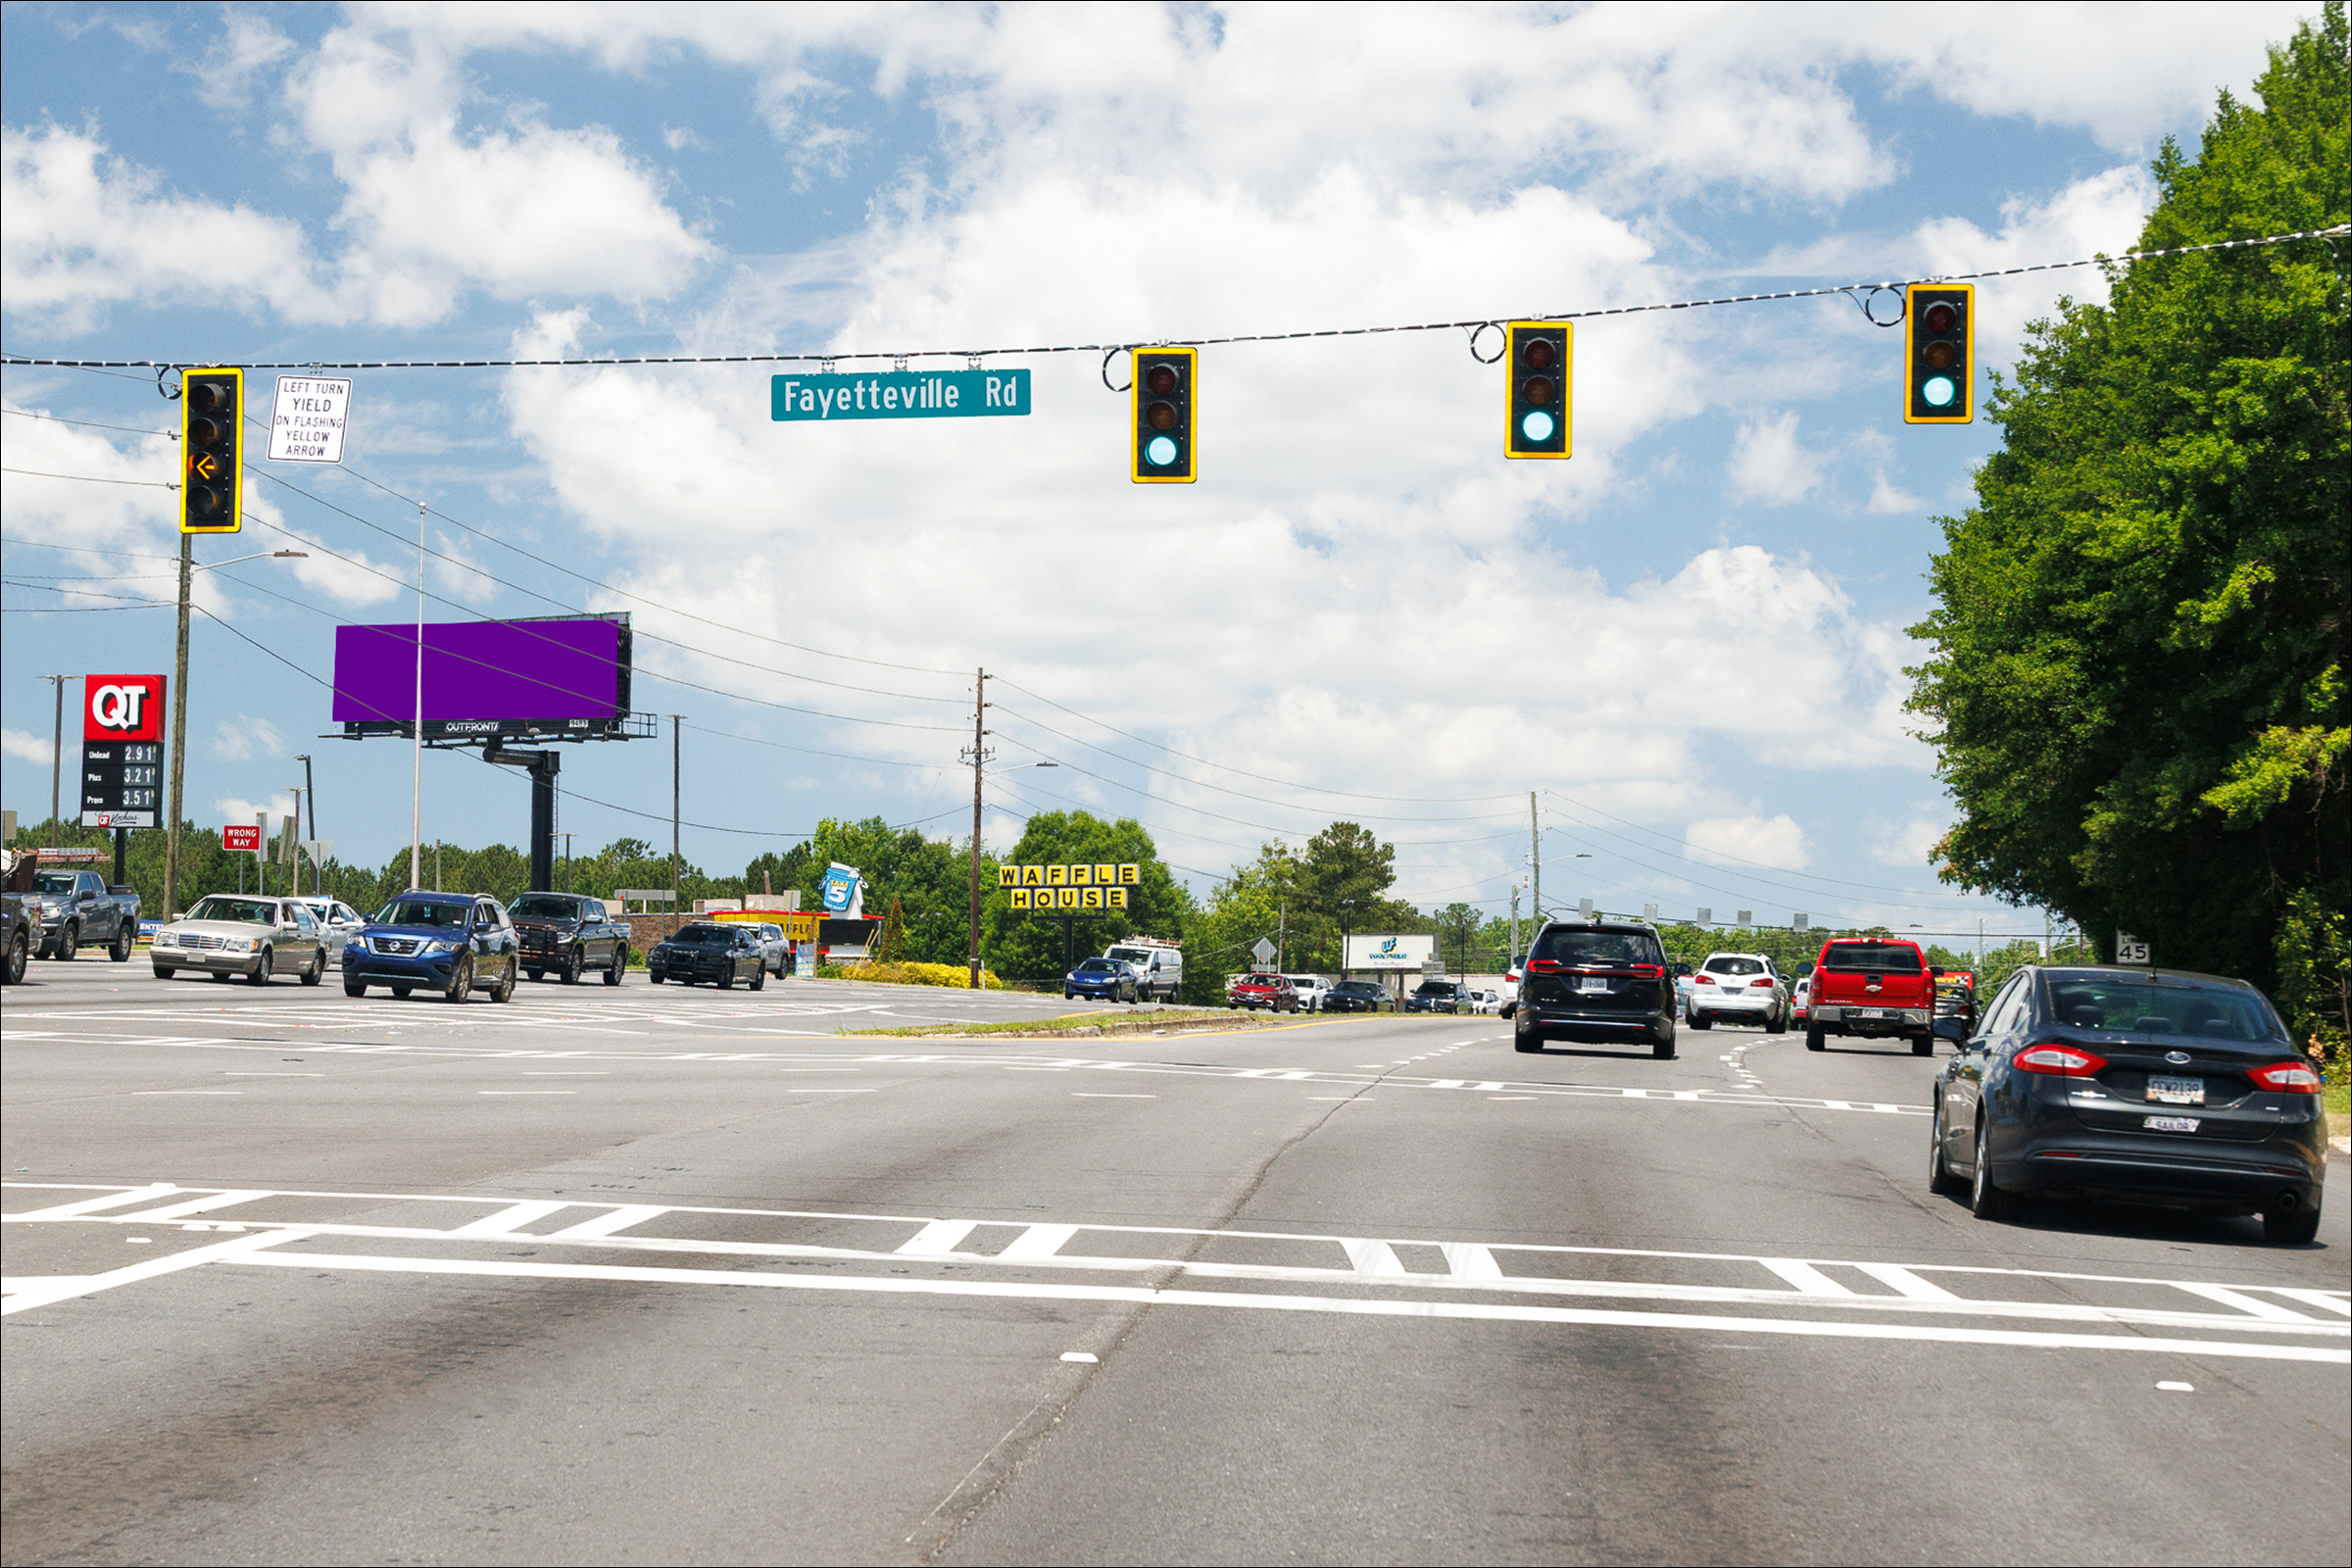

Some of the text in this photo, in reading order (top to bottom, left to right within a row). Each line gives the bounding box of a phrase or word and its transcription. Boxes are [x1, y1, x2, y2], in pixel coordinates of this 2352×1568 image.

[283, 381, 344, 395] LEFT TURN
[785, 376, 1017, 418] Fayetteville Rd
[293, 398, 331, 413] YIELD
[275, 415, 343, 429] ON FLASHING
[286, 430, 330, 443] YELLOW
[285, 445, 325, 457] ARROW
[92, 684, 150, 735] QT
[87, 773, 102, 782] Plus
[86, 796, 104, 805] Prem
[227, 828, 257, 838] WRONG
[232, 838, 251, 847] WAY
[1002, 867, 1134, 884] WAFFLE
[830, 879, 850, 888] TAKE
[828, 886, 849, 904] 5
[1013, 891, 1122, 906] HOUSE
[2119, 945, 2147, 959] 45
